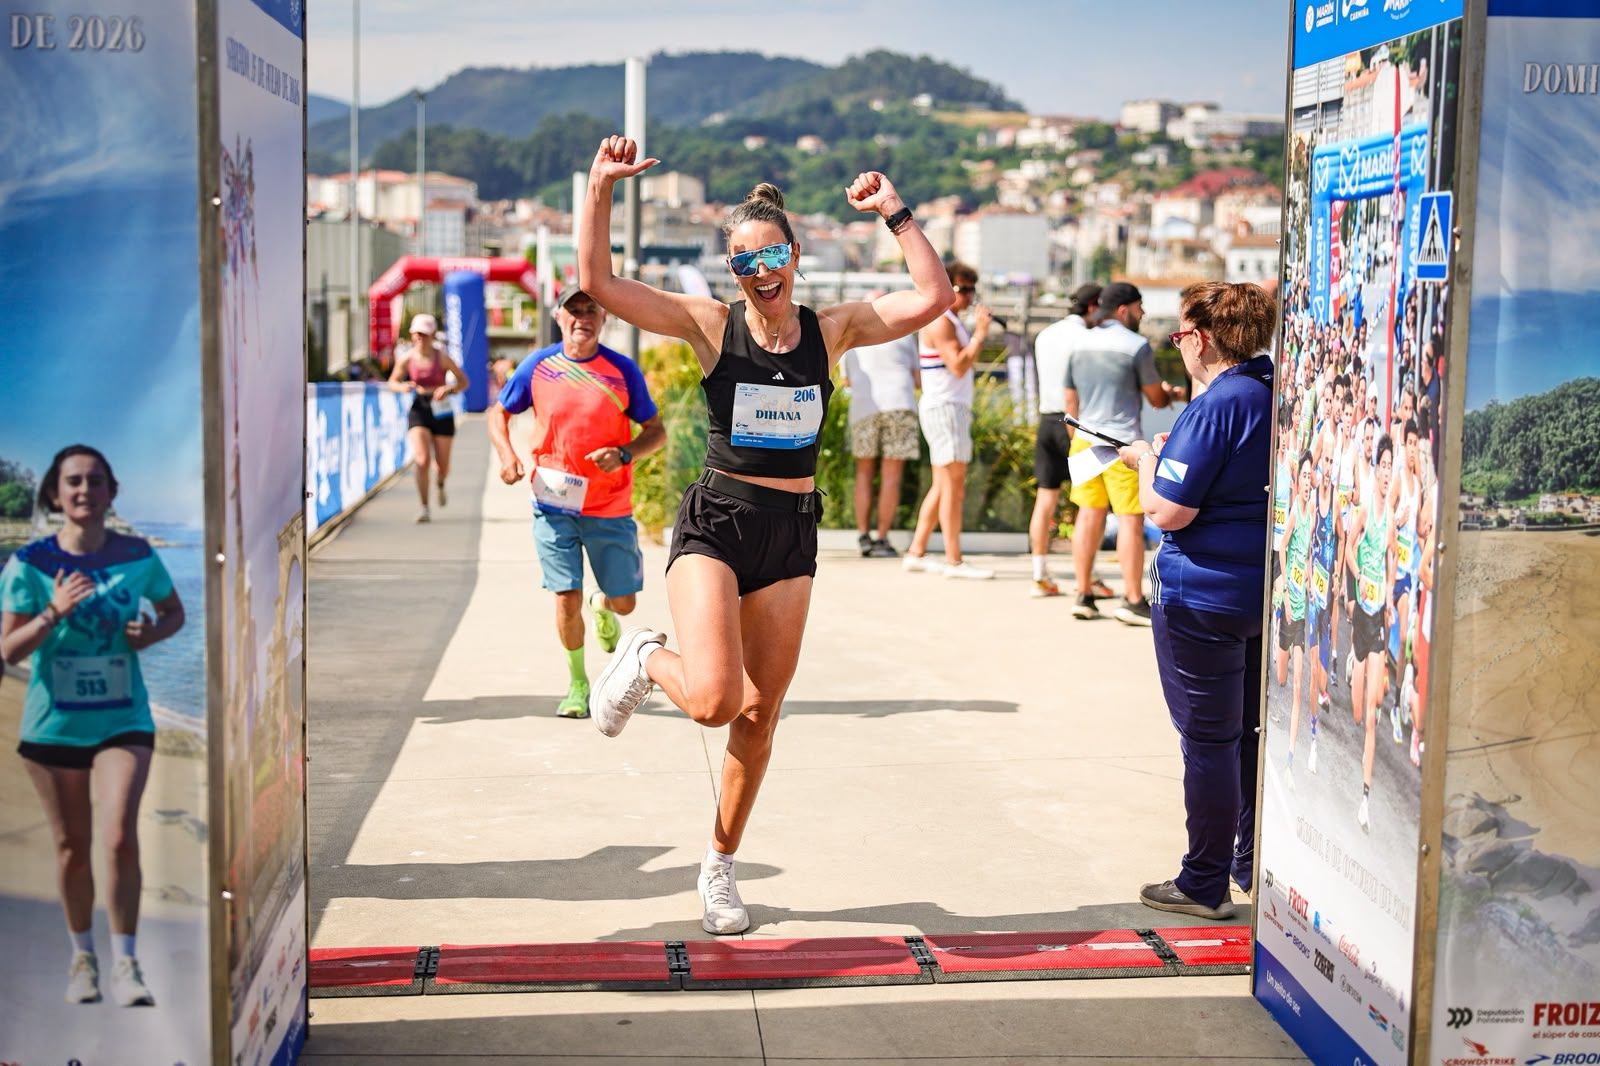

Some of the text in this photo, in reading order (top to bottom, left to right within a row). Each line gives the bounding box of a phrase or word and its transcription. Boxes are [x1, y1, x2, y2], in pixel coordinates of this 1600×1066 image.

[8, 12, 146, 52] DE 2026
[1523, 62, 1599, 95] DOMI
[793, 388, 816, 403] 206
[755, 409, 802, 421] DIHANA
[1288, 886, 1309, 922] FROIZ
[1293, 935, 1311, 959] BROOKS
[1477, 1008, 1525, 1018] Deputación
[1533, 1002, 1600, 1026] FROIZ
[1476, 1017, 1525, 1025] Pontevedra
[1533, 1031, 1541, 1039] el
[1542, 1031, 1566, 1040] súper
[1568, 1030, 1580, 1039] de
[1444, 1057, 1516, 1066] CROWDSTRIKE
[1553, 1053, 1600, 1065] BROO
